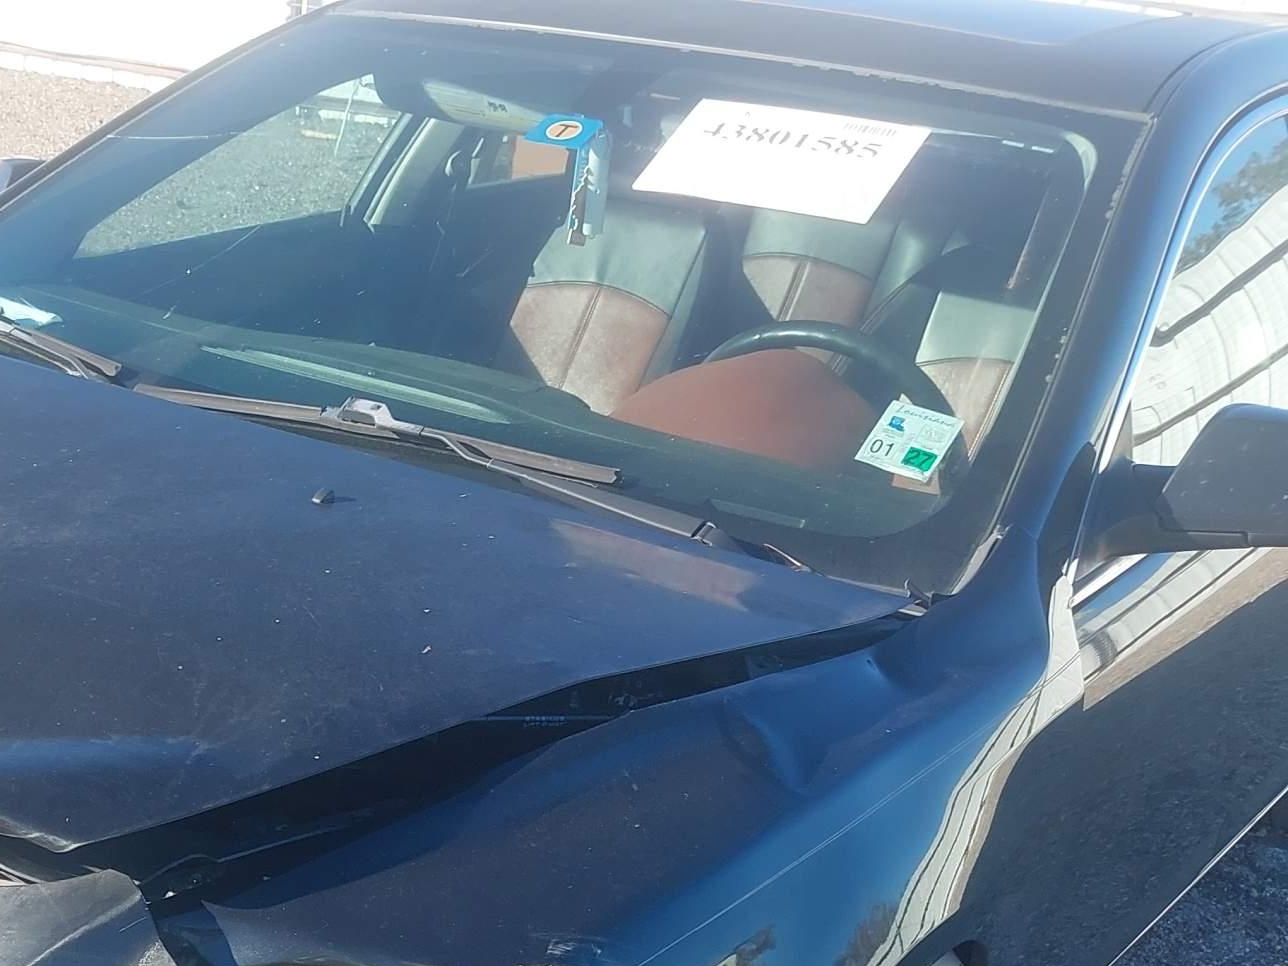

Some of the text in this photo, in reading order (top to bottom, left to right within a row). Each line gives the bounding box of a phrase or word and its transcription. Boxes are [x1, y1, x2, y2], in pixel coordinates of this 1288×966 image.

[555, 123, 579, 138] T
[869, 438, 895, 457] 01
[907, 449, 933, 469] 27
